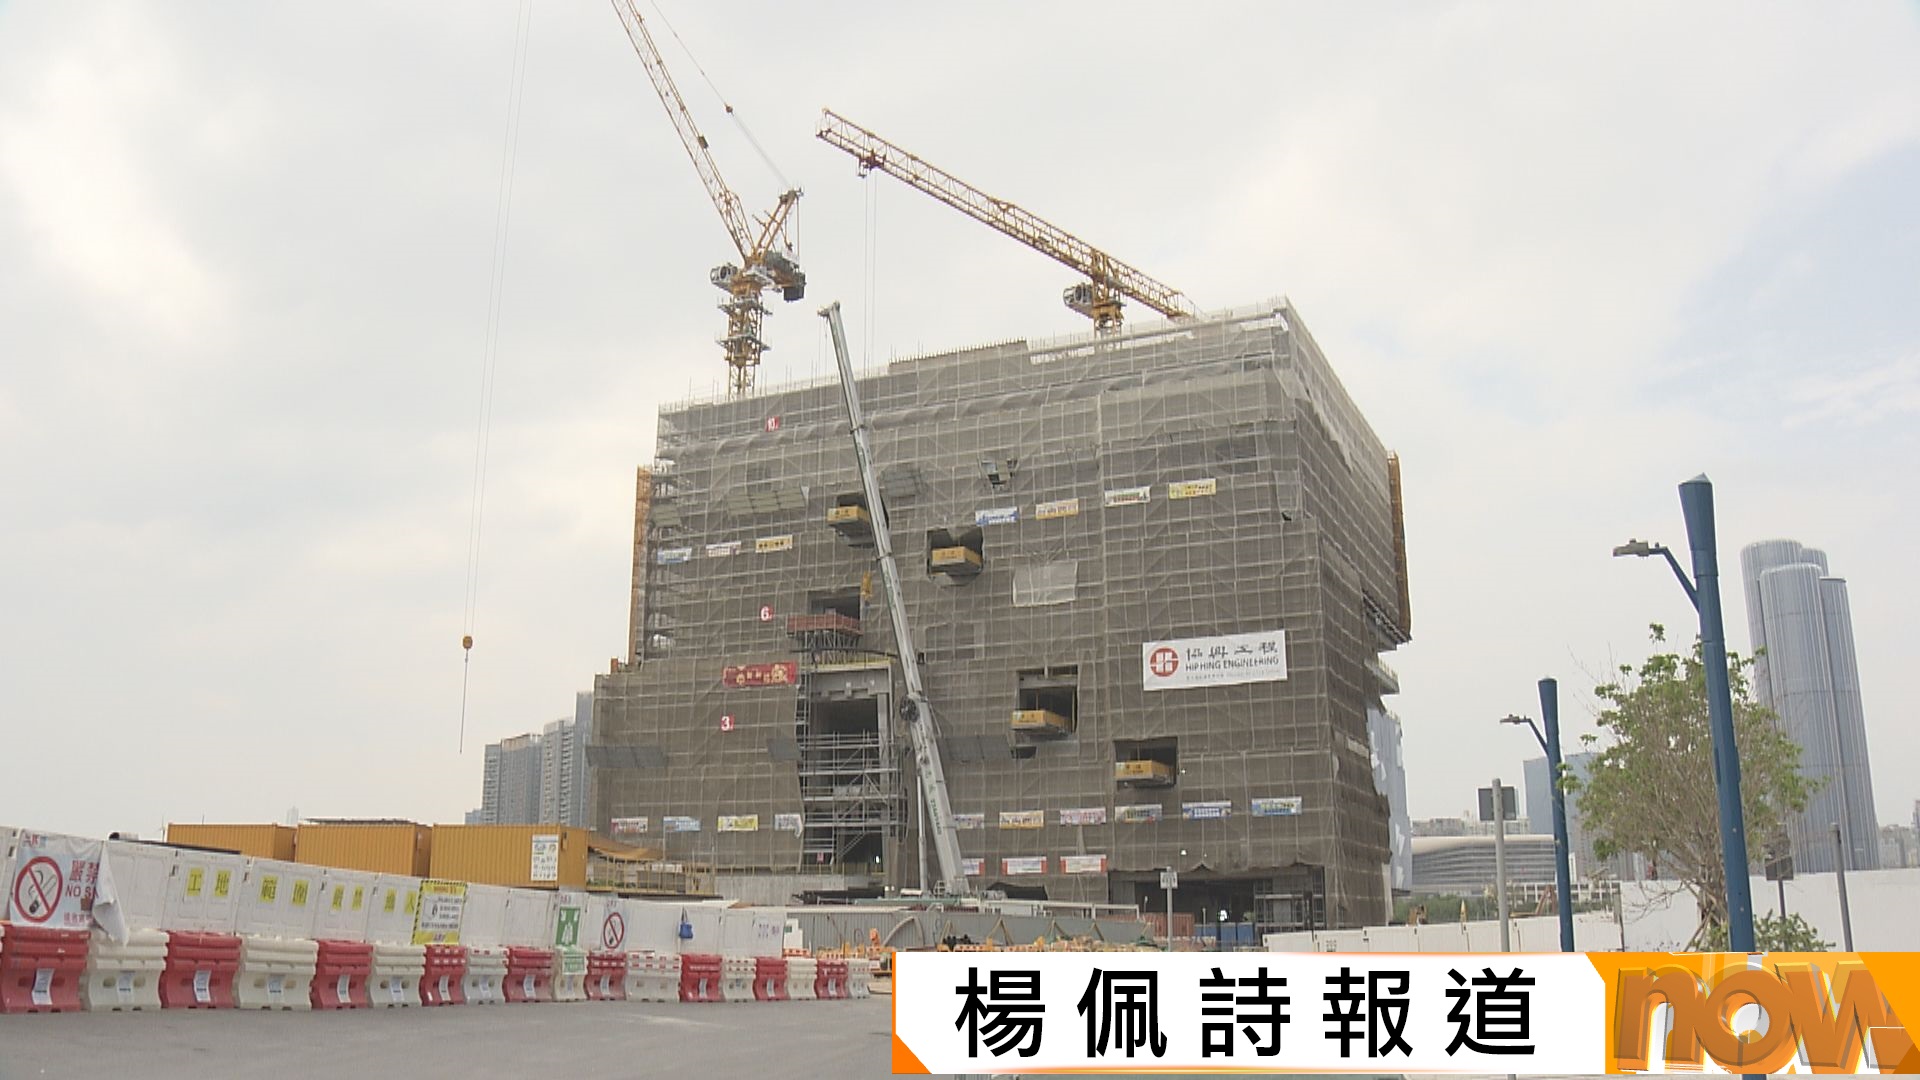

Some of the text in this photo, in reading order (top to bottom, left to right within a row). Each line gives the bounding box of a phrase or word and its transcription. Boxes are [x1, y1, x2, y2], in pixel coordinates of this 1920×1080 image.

[1185, 656, 1279, 672] HIP HING ENGINEERING
[65, 885, 81, 897] NO
